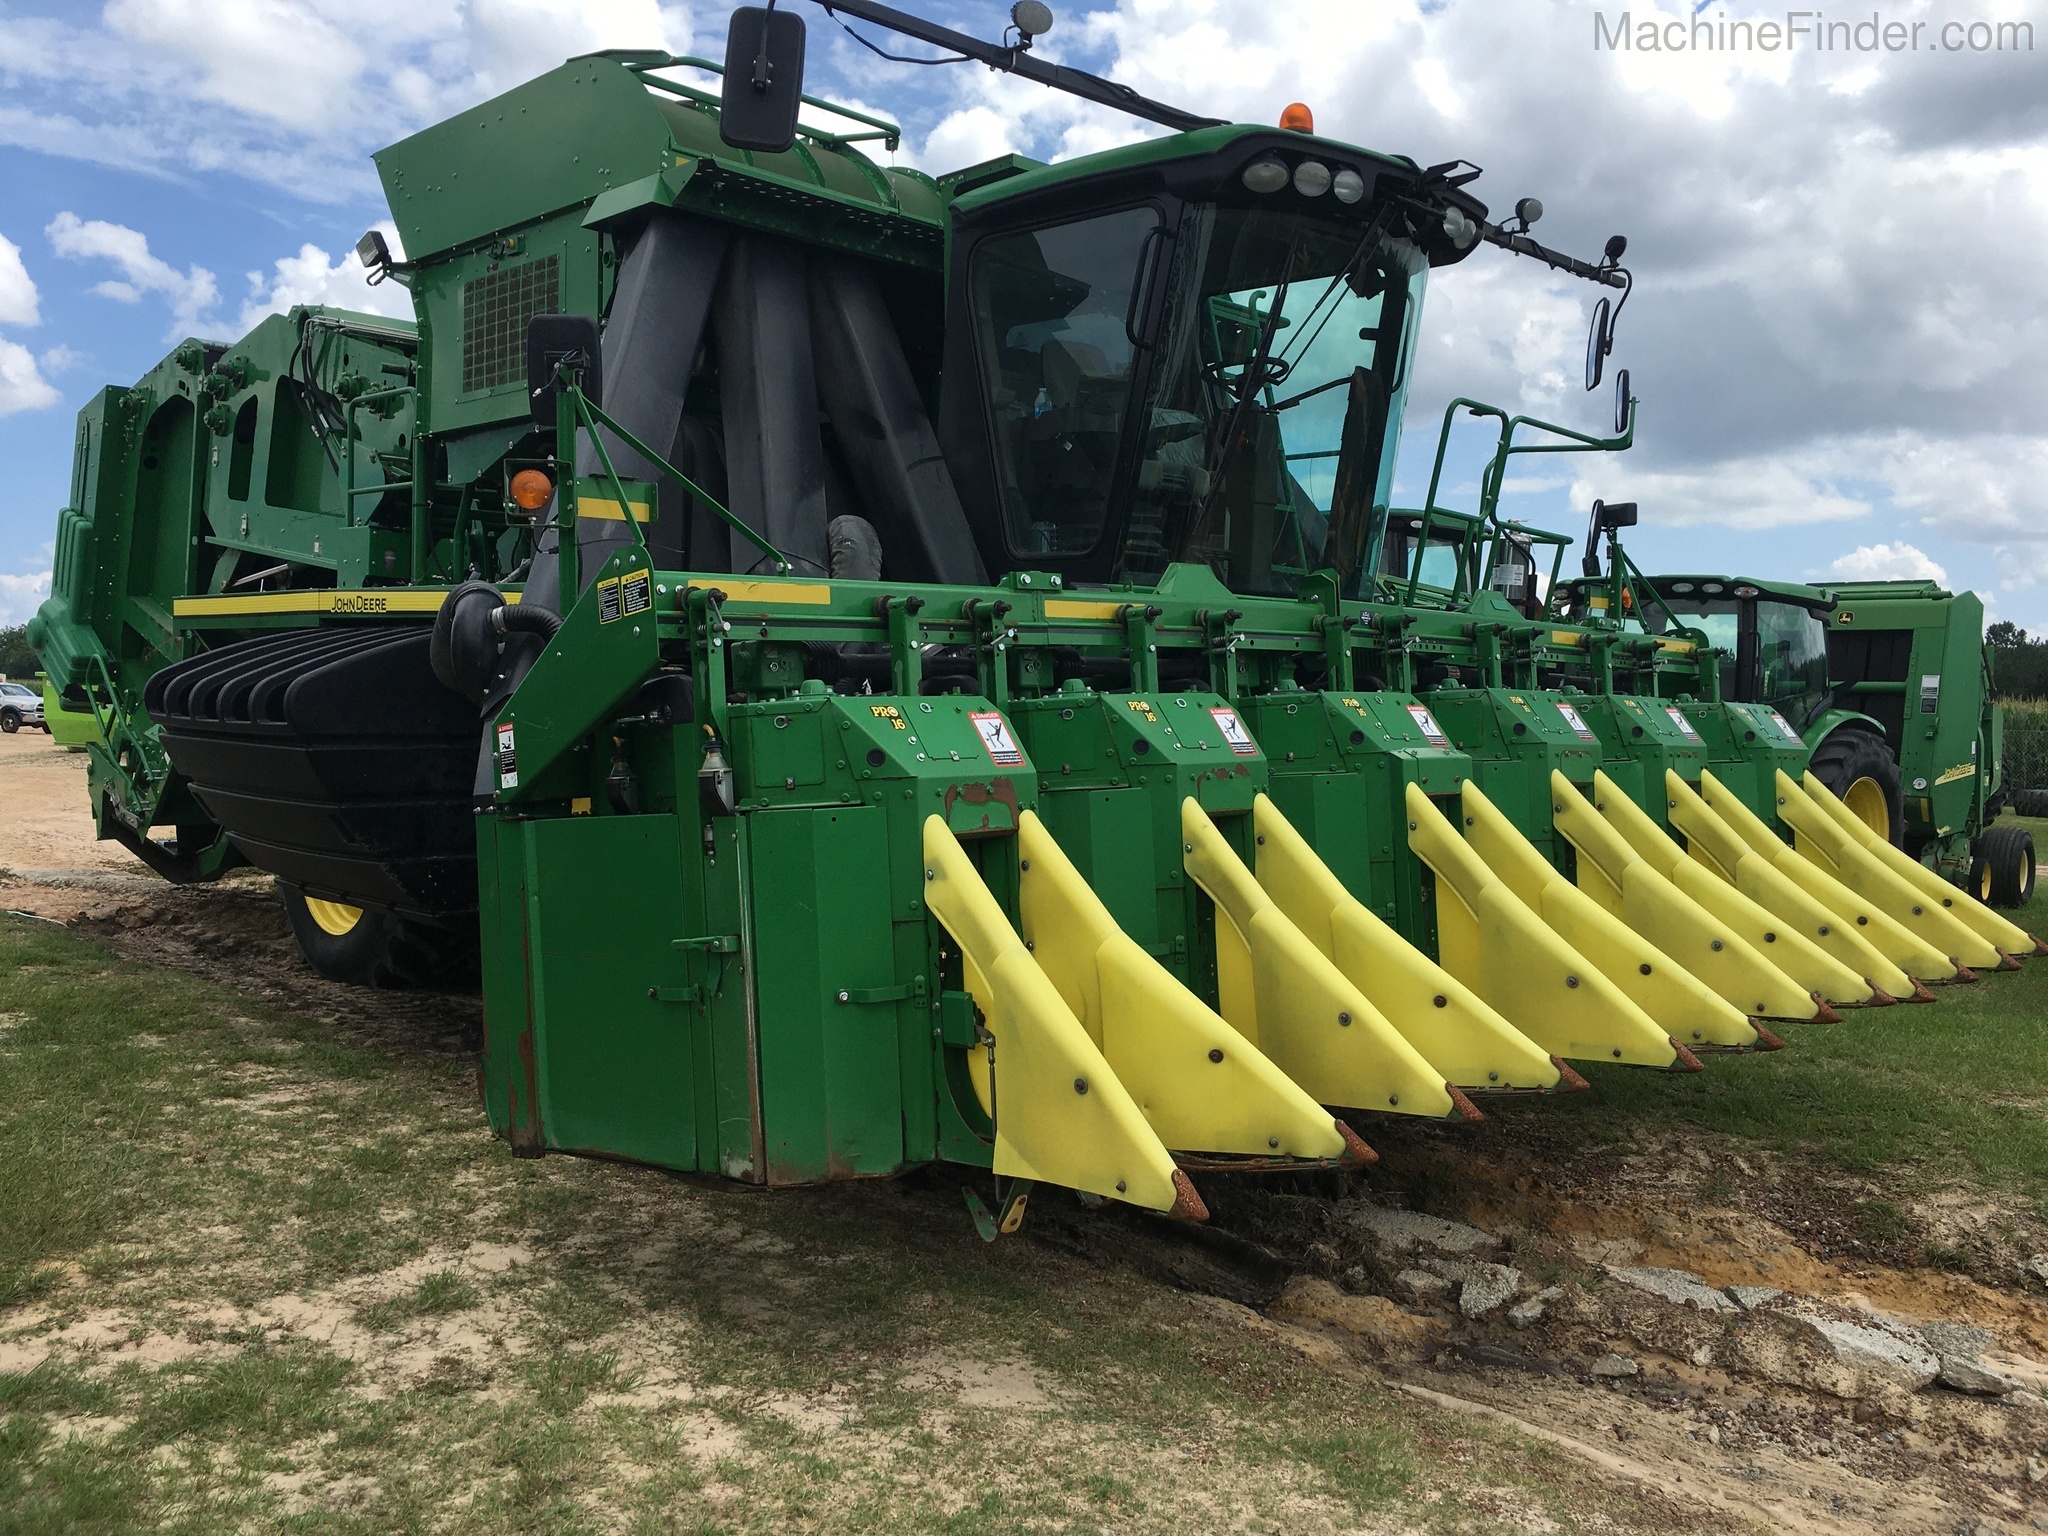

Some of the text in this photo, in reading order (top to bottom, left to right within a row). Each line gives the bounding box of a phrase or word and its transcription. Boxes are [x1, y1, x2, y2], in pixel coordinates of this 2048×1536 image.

[870, 705, 899, 717] PRO
[1128, 701, 1150, 711] PRO
[1144, 712, 1157, 722] 16
[891, 718, 906, 730] 16
